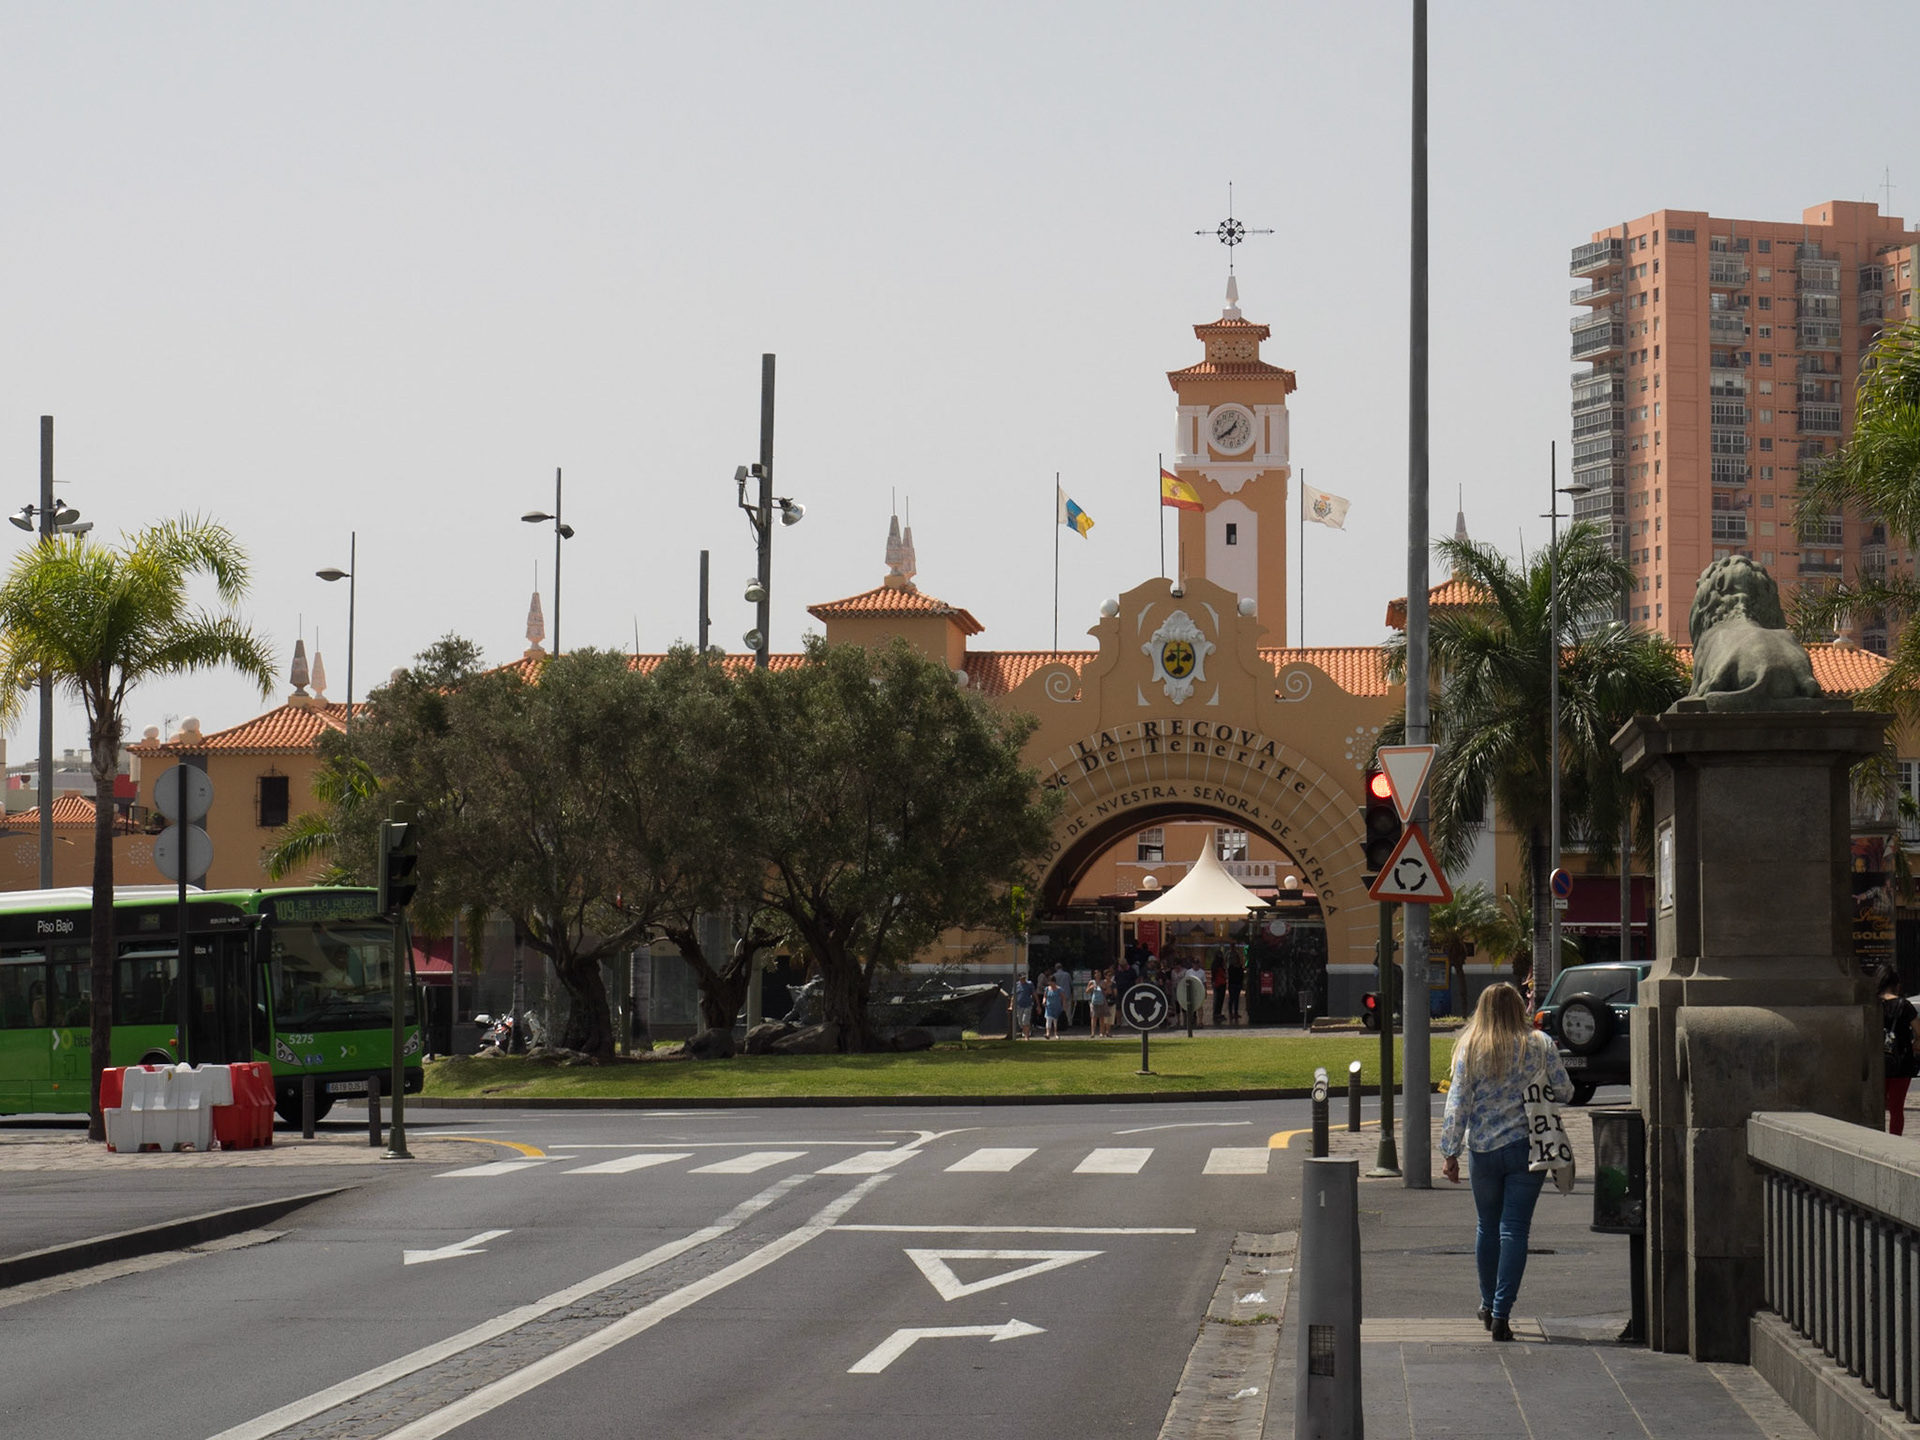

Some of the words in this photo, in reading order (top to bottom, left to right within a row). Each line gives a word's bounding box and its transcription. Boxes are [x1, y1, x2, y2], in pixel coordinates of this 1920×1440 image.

[1077, 731, 1115, 755] LA
[1143, 720, 1275, 757] RECOVA
[1081, 750, 1117, 772] De
[1146, 737, 1306, 793] Tenerife
[1030, 842, 1061, 882] CADO
[1067, 816, 1088, 836] DE
[1096, 786, 1177, 816] NVESTRA
[1193, 784, 1259, 818] SEÑORA
[1271, 819, 1291, 839] DE
[1297, 847, 1338, 916] AFRICA
[37, 920, 54, 933] Piso
[56, 919, 74, 934] Bajo
[289, 1034, 314, 1045] 5275
[1528, 1114, 1564, 1135] ar
[1528, 1139, 1572, 1164] ko
